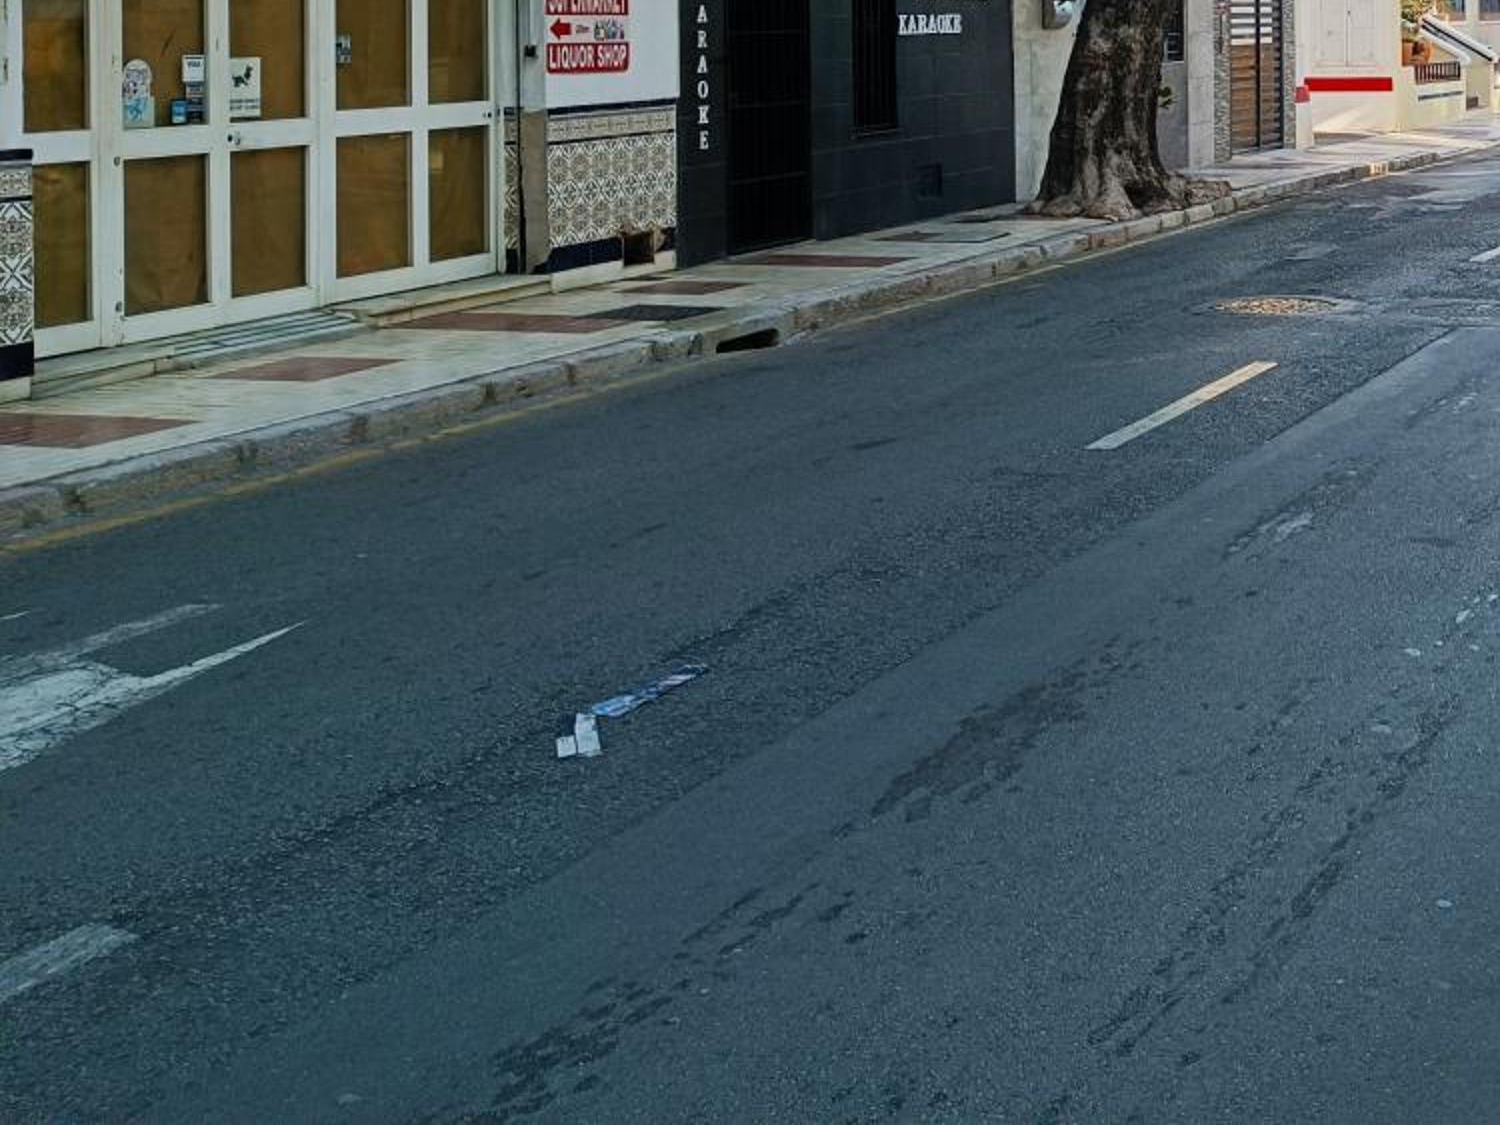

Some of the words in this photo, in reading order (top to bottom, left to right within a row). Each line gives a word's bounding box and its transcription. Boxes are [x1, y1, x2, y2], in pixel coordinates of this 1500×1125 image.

[897, 13, 963, 36] KARAOKE
[548, 44, 595, 69] LIQUOR
[597, 44, 627, 68] SHOP
